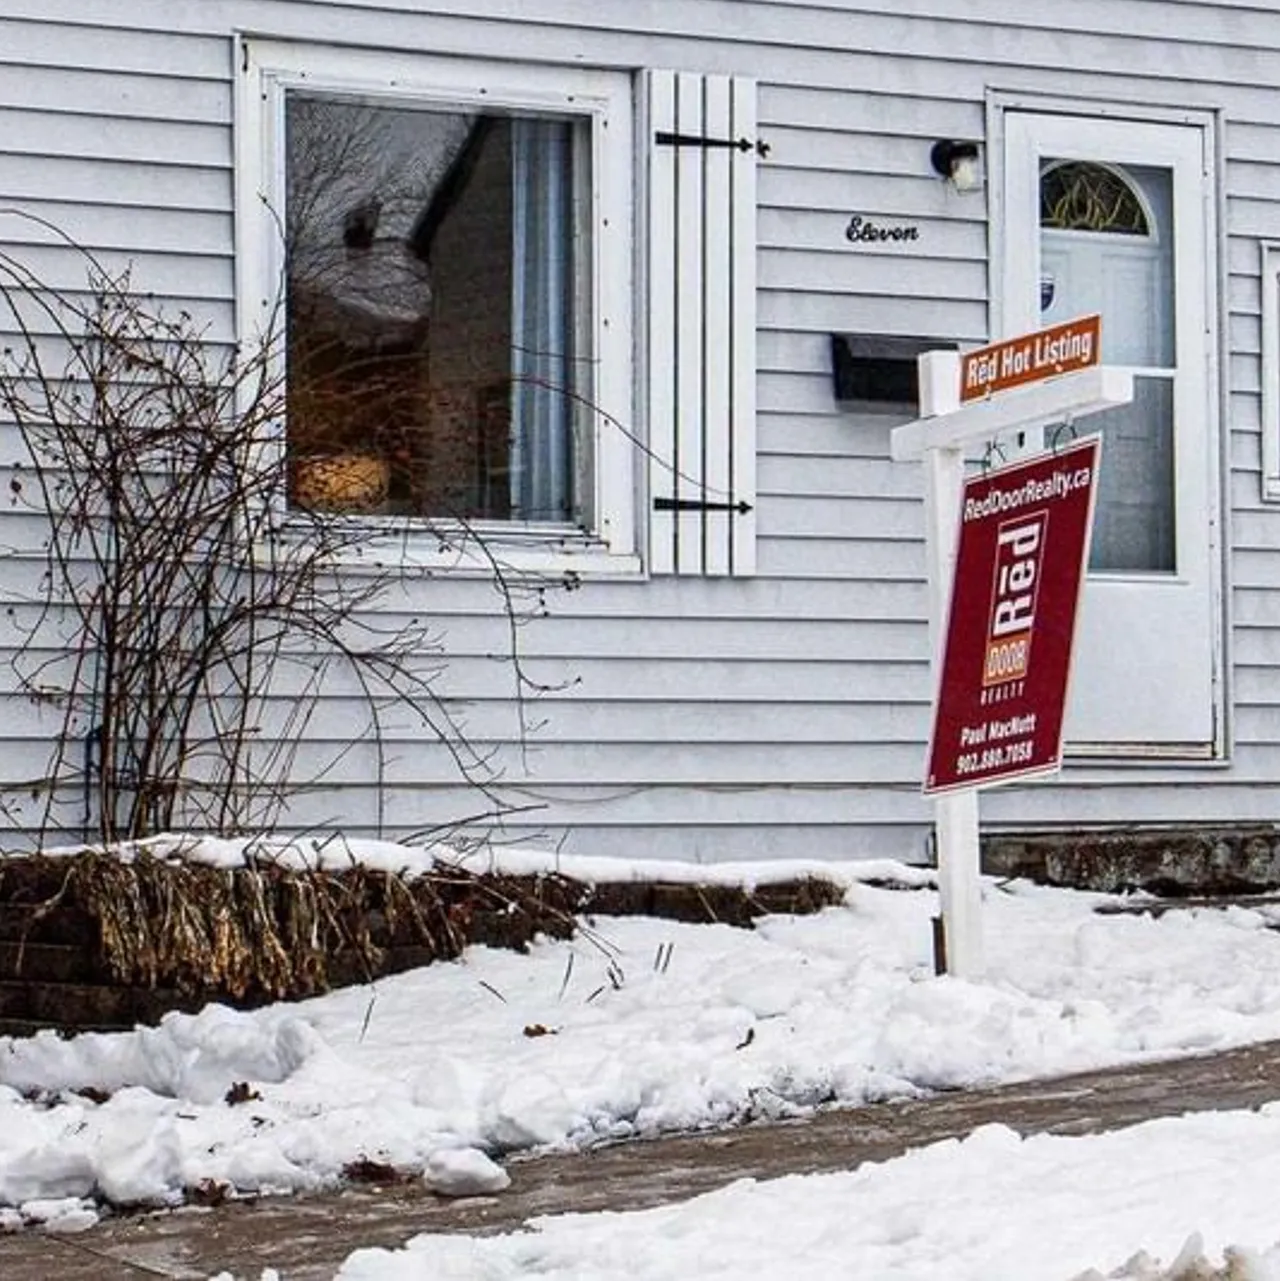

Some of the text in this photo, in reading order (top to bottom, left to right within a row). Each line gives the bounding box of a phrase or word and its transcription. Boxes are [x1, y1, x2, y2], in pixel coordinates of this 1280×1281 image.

[845, 214, 920, 243] Eleven
[1001, 346, 1031, 378] Hot
[1034, 330, 1093, 368] Listing
[964, 467, 1091, 522] RedDoorRealty.ca
[987, 640, 1027, 678] DOOR
[980, 681, 1025, 707] REALTY
[960, 712, 1037, 749] Paul MacNutt
